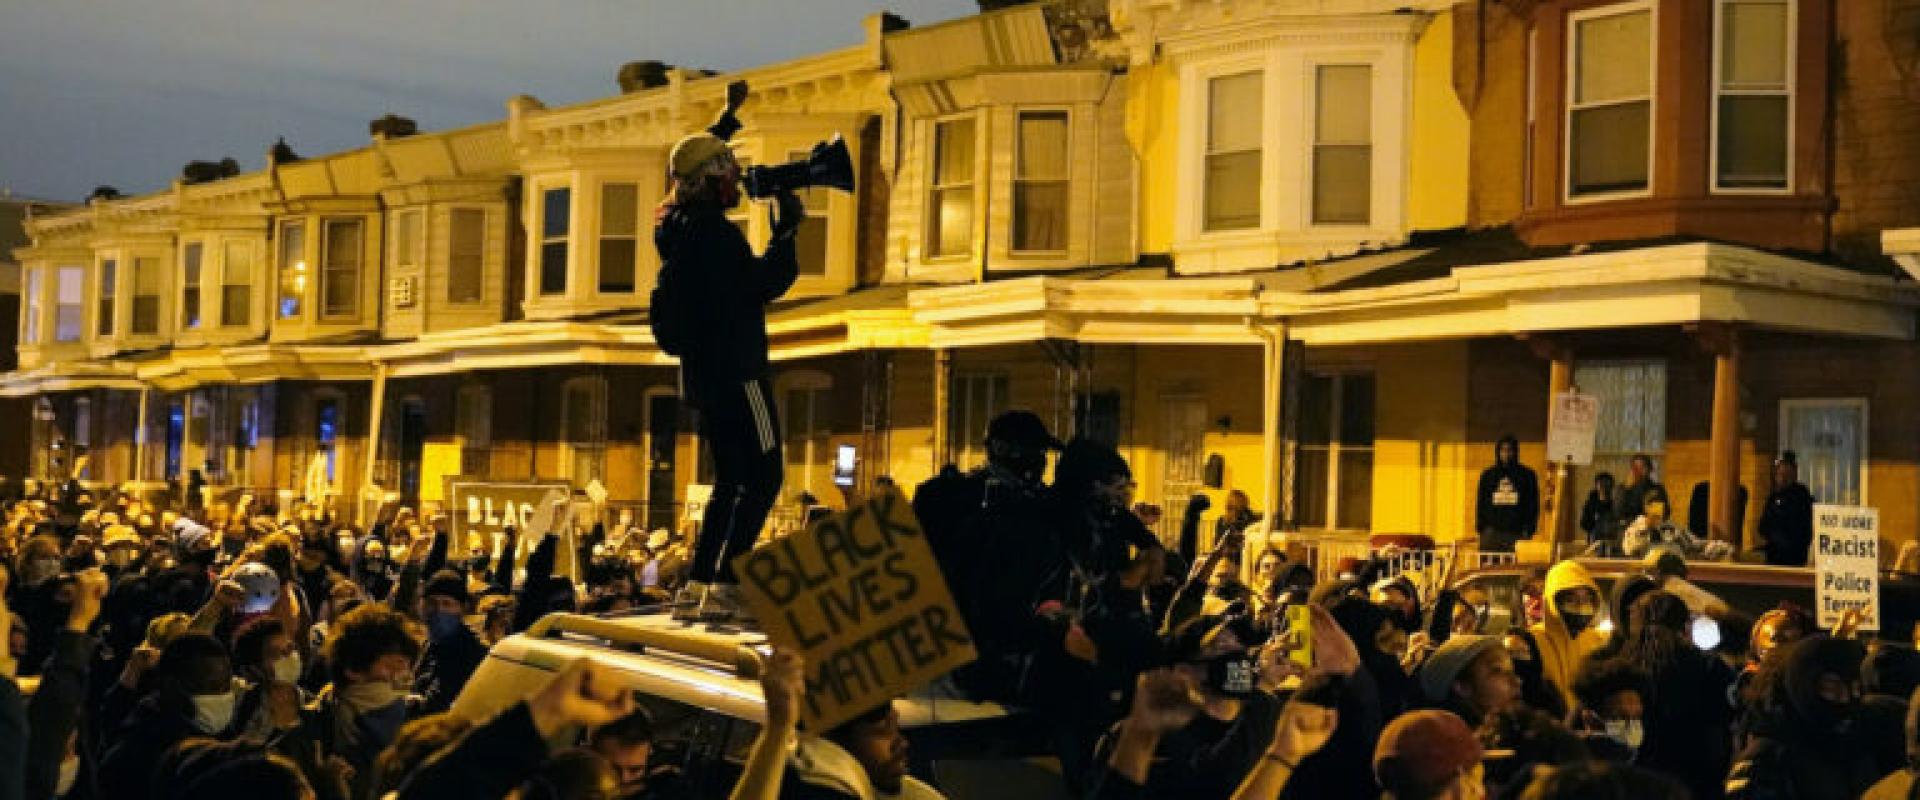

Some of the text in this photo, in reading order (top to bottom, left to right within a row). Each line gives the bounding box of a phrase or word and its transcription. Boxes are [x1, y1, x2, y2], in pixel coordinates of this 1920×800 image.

[467, 496, 534, 529] BLAC
[746, 494, 919, 606] BLACK
[1819, 534, 1876, 558] Racist
[785, 552, 917, 648] LIVES
[1824, 572, 1871, 593] Police
[804, 605, 971, 718] MATTER
